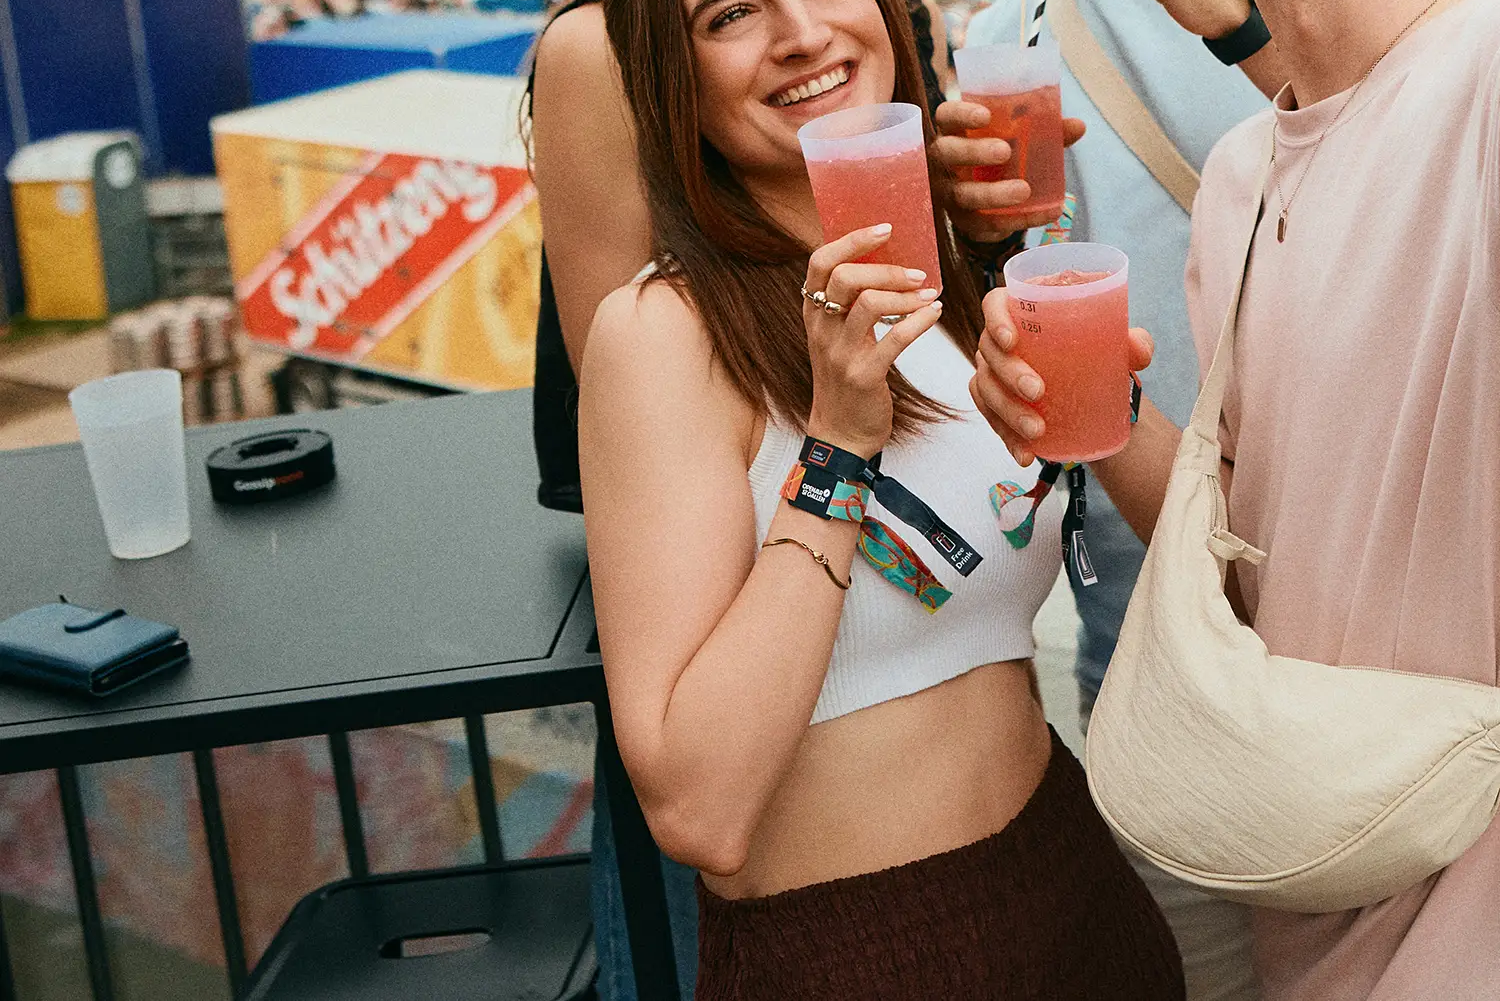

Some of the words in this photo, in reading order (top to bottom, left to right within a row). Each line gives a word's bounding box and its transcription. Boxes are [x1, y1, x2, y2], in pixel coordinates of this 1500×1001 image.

[1020, 301, 1036, 313] 0.3l
[950, 547, 965, 562] Free
[955, 551, 973, 570] Drink
